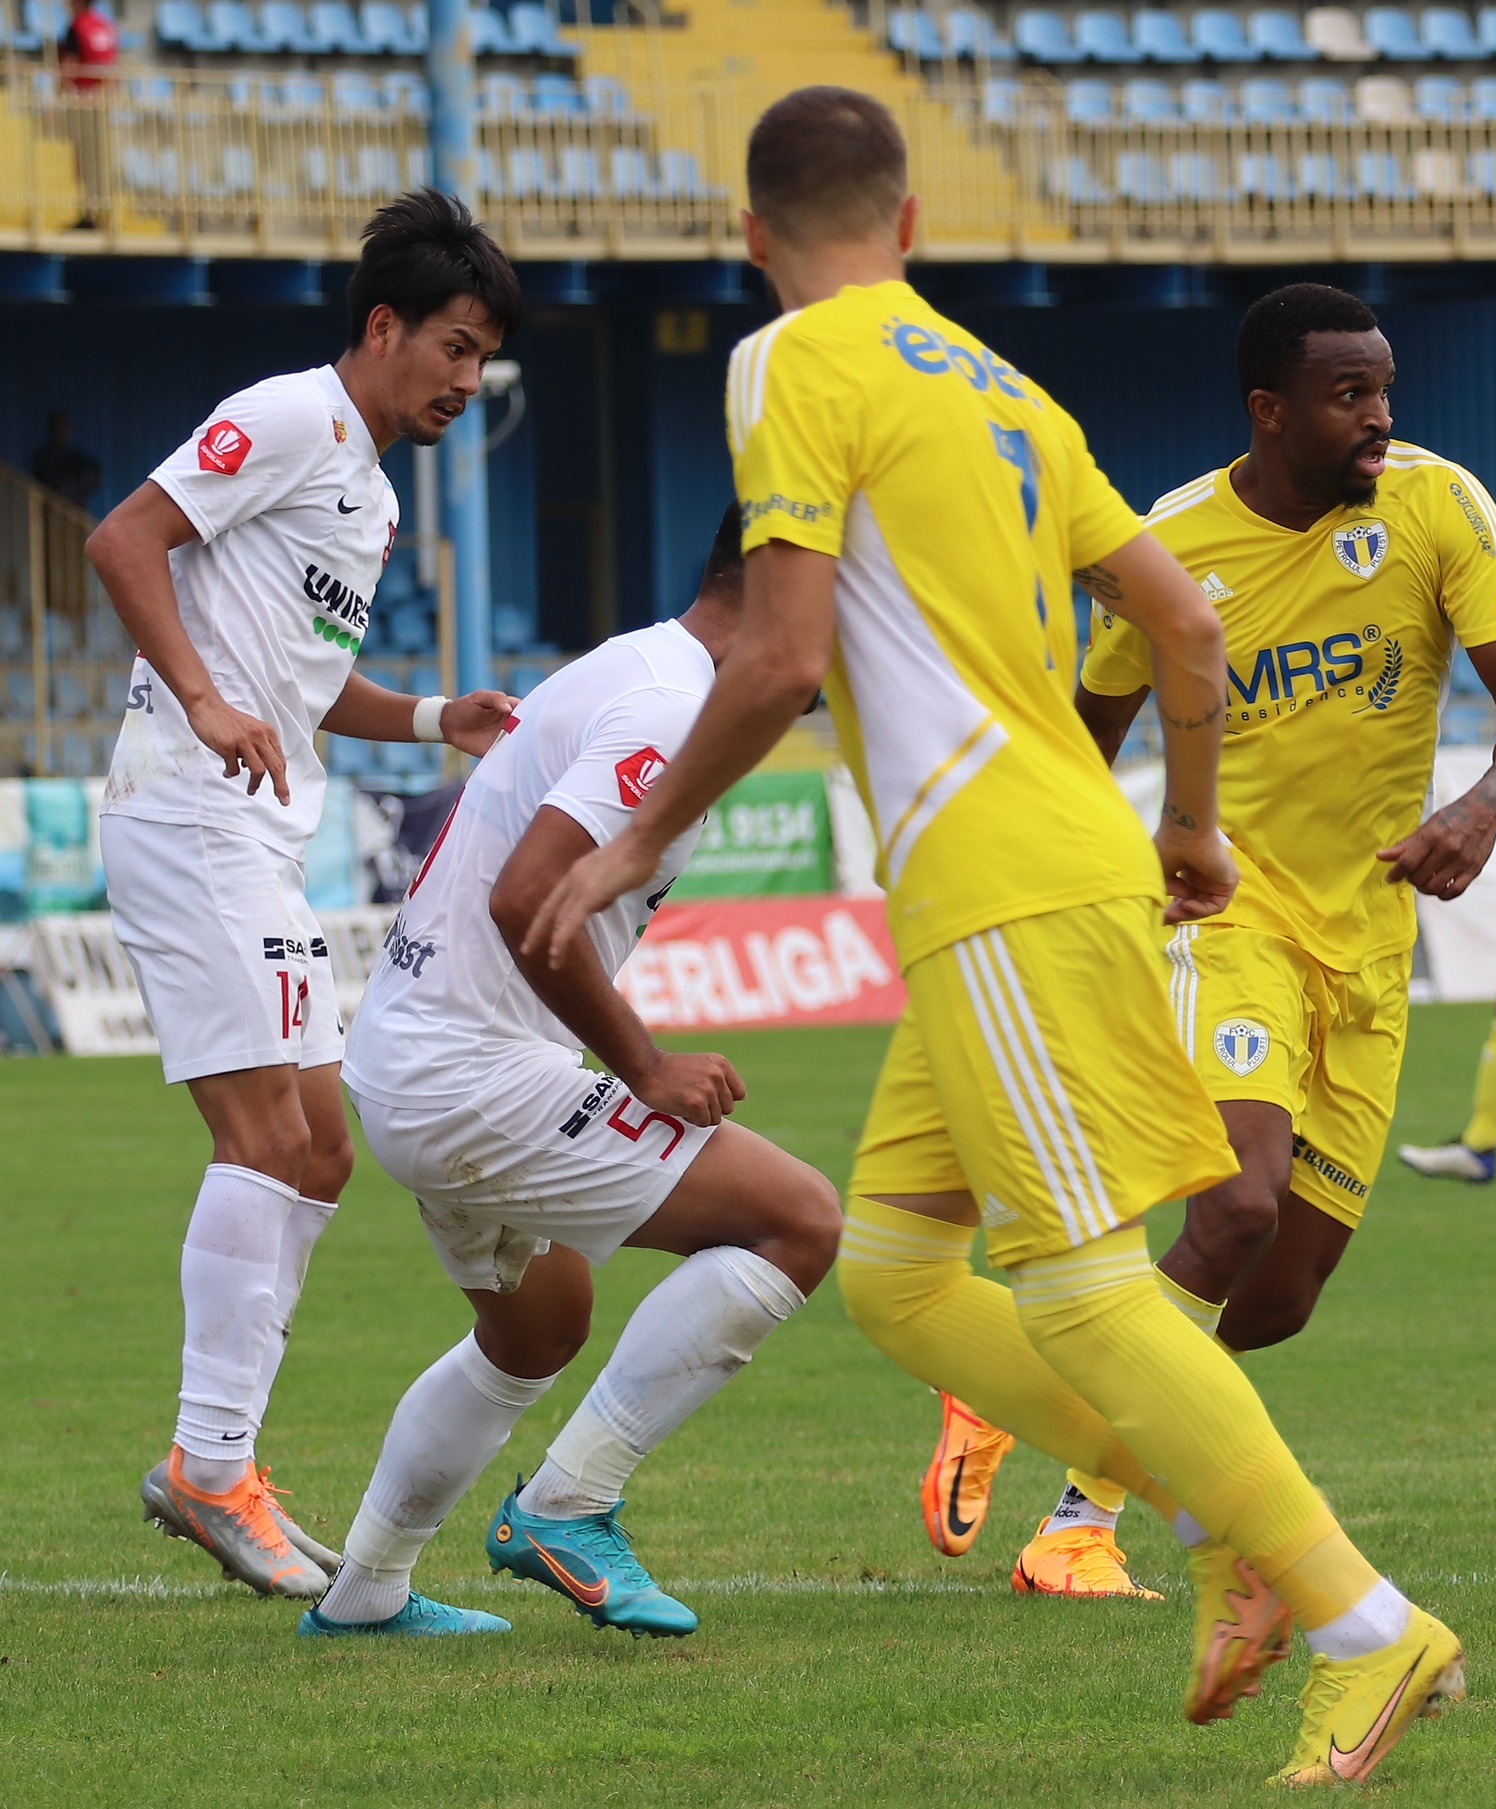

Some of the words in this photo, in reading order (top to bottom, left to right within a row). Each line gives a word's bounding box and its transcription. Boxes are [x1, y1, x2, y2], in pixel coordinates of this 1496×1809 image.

[1457, 495, 1488, 535] EXCLUSIVE
[1217, 1033, 1236, 1068] PETROLUL
[1246, 1036, 1266, 1067] PLOIESTI
[606, 1094, 686, 1162] 5
[1303, 1148, 1368, 1199] BARRIER
